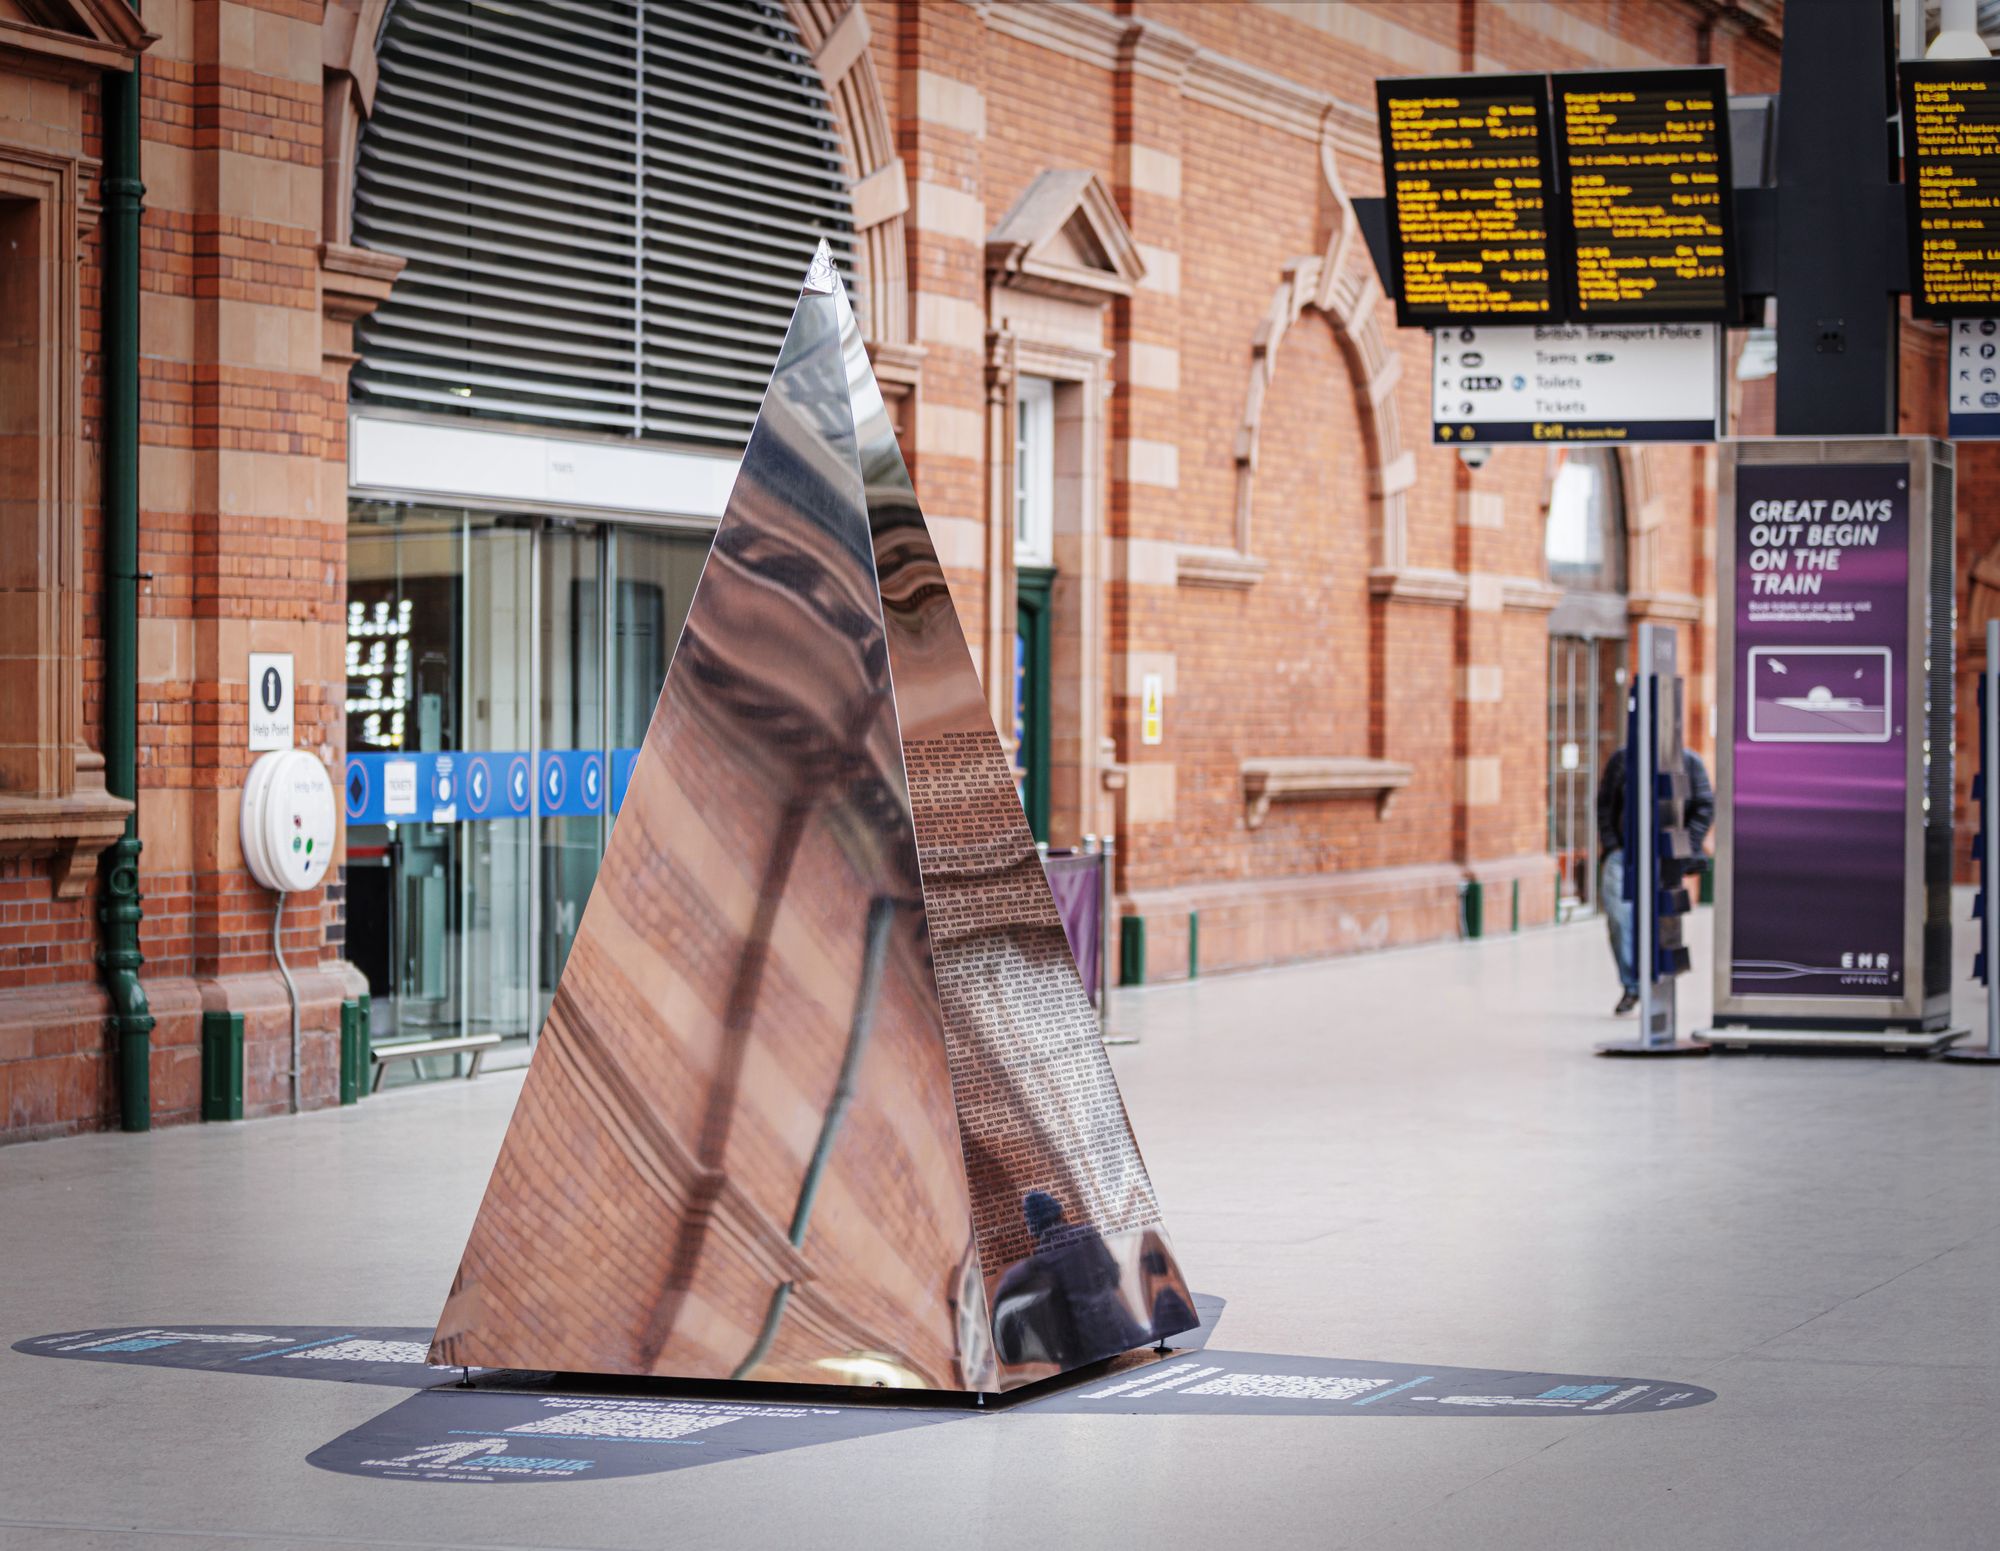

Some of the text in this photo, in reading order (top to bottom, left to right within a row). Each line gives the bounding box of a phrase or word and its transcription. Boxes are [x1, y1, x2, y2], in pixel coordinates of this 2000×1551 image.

[1915, 81, 1986, 91] Departures
[1915, 103, 1965, 113] Norwich
[1919, 177, 1977, 187] Skegness
[1922, 250, 1983, 261] Liverpool
[1535, 326, 1702, 342] British Transport Police
[1536, 352, 1577, 365] Trams
[1536, 376, 1581, 389] Toilets
[1536, 400, 1586, 414] Tickets
[1533, 423, 1565, 440] Exit
[1749, 499, 1893, 522] GREAT DAYS
[1749, 524, 1879, 546] OUT BEGIN
[1749, 549, 1841, 571] ON THE
[1751, 573, 1822, 595] TRAIN
[254, 723, 289, 736] Help Point
[1841, 952, 1889, 968] EMR
[539, 1397, 665, 1407] Remember
[619, 1406, 722, 1414] prostate
[462, 1460, 559, 1469] CANCER
[479, 1456, 596, 1465] PROSTATE
